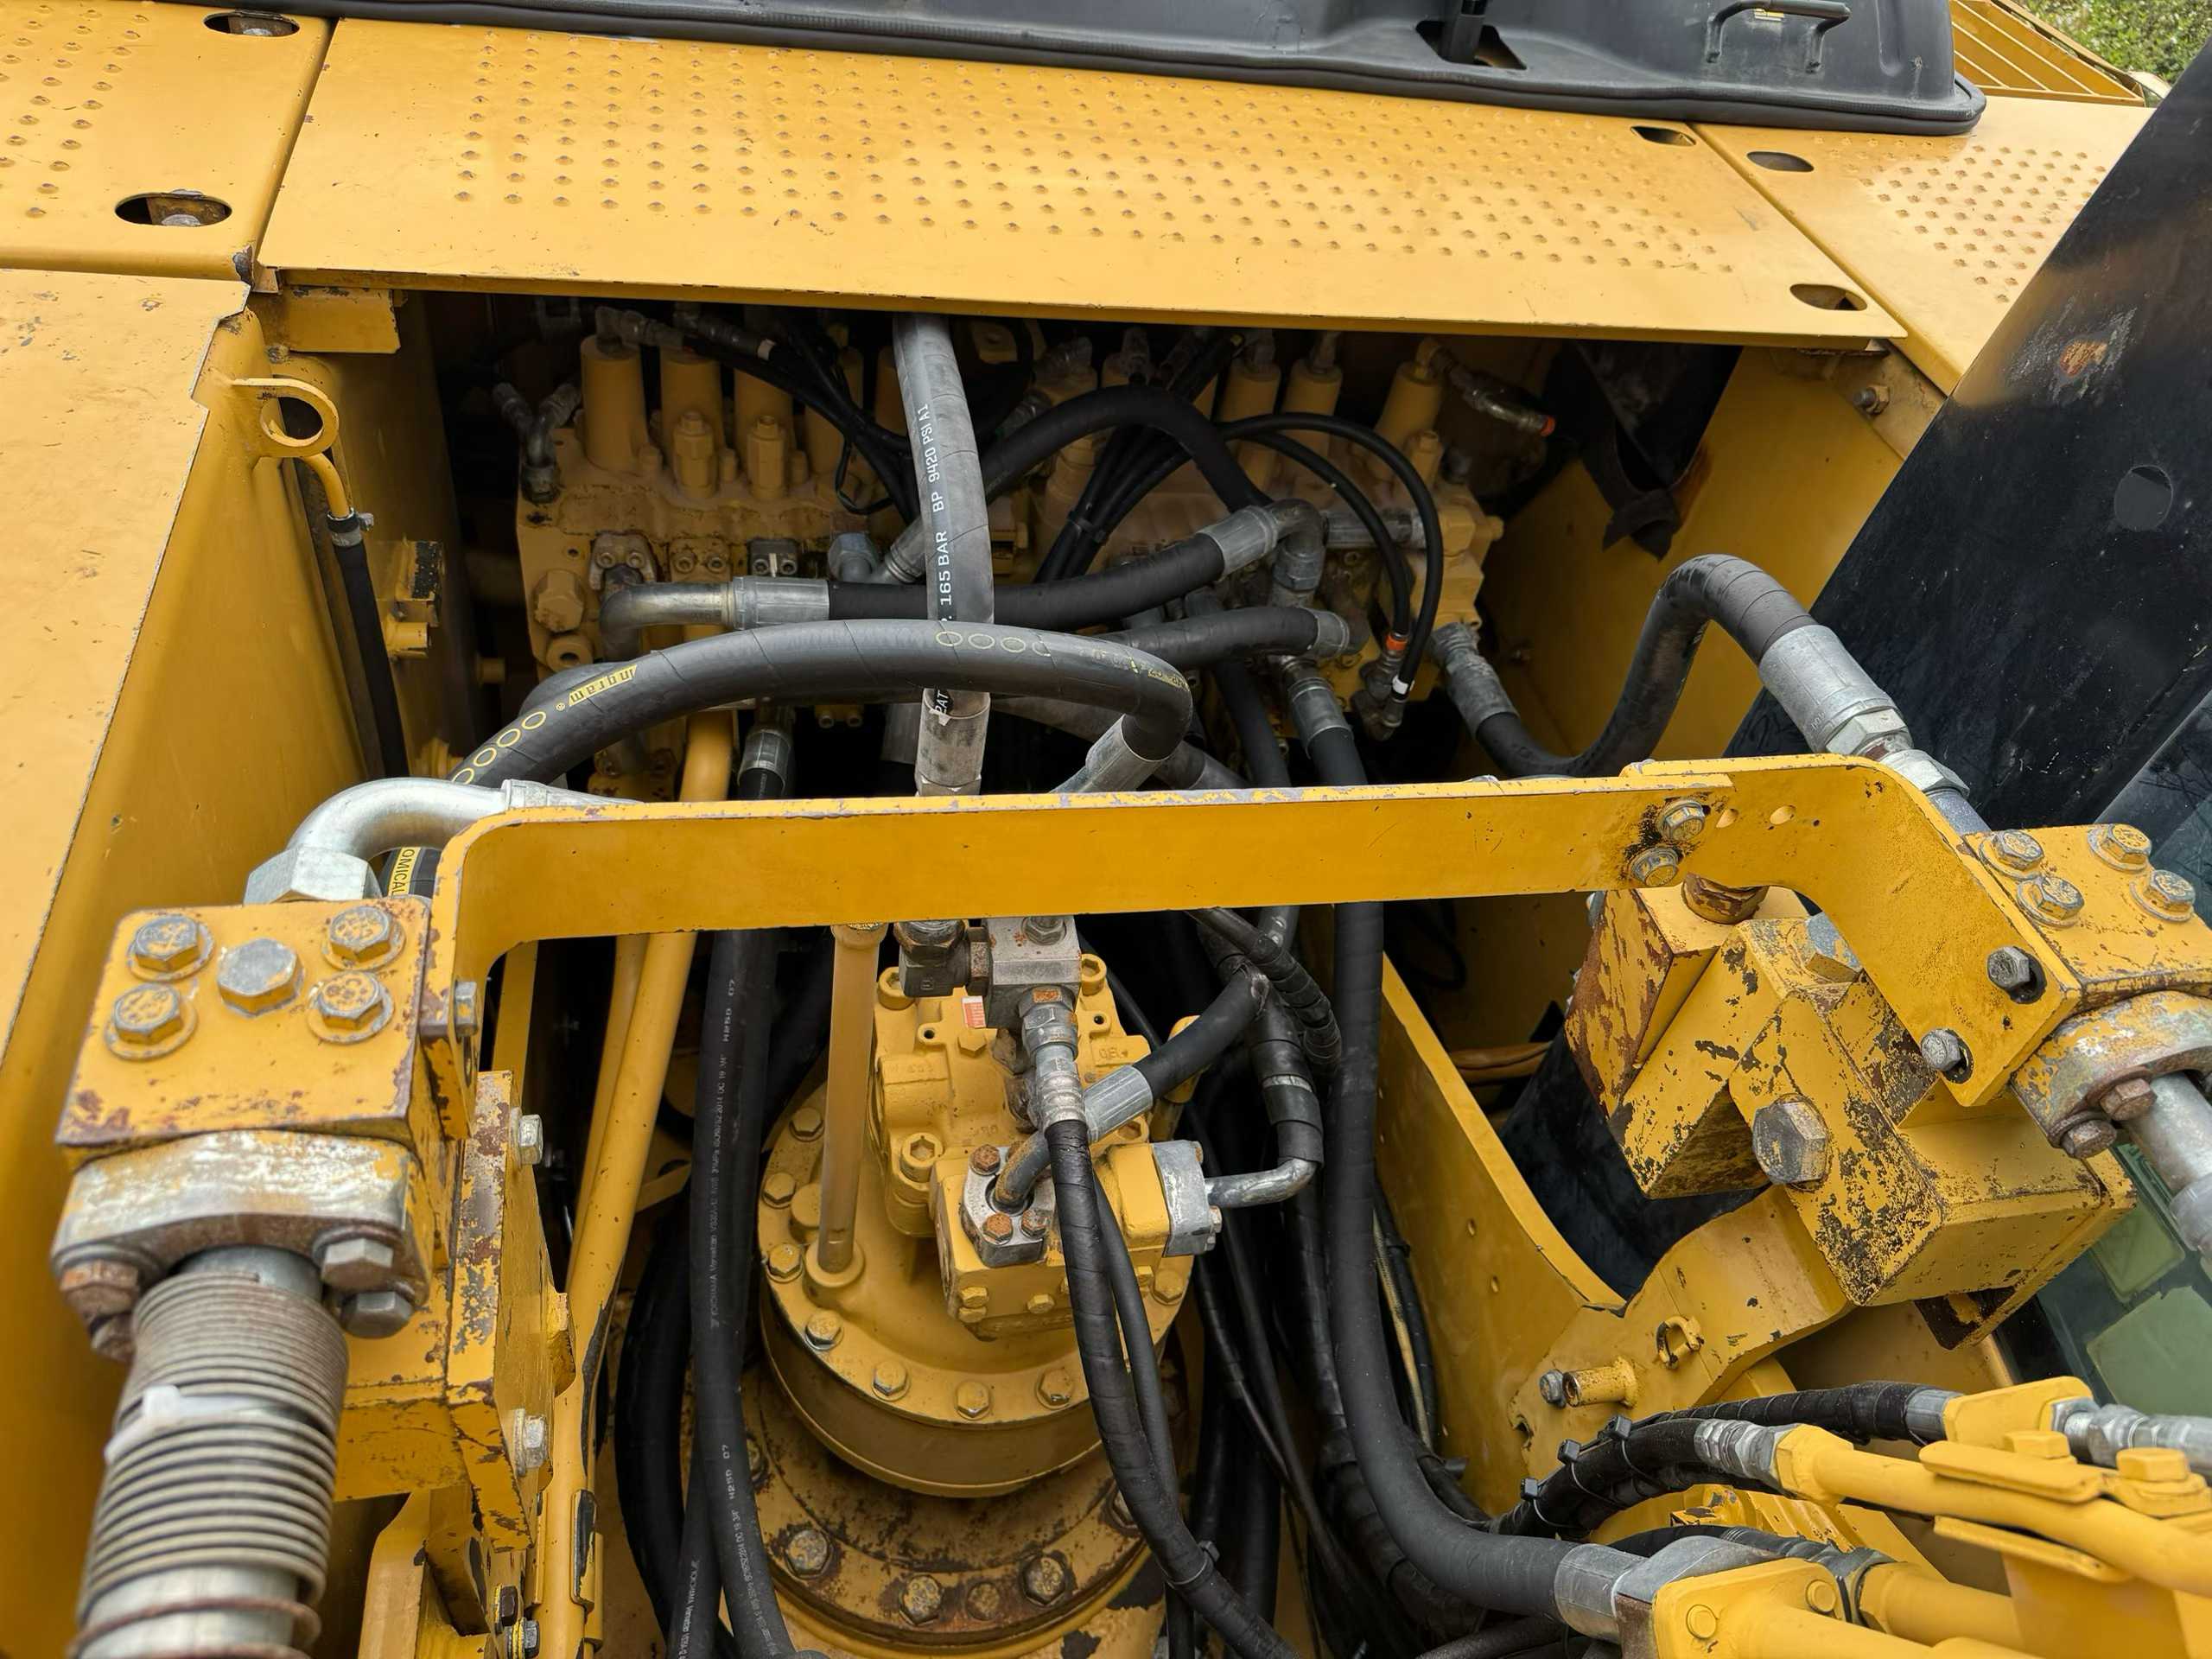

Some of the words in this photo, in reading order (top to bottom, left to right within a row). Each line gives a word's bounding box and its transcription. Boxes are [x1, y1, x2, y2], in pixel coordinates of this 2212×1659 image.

[920, 423, 934, 445] PSI
[925, 447, 940, 483] 9420
[931, 491, 944, 512] BP
[935, 531, 950, 566] BAR
[938, 569, 951, 606] 165
